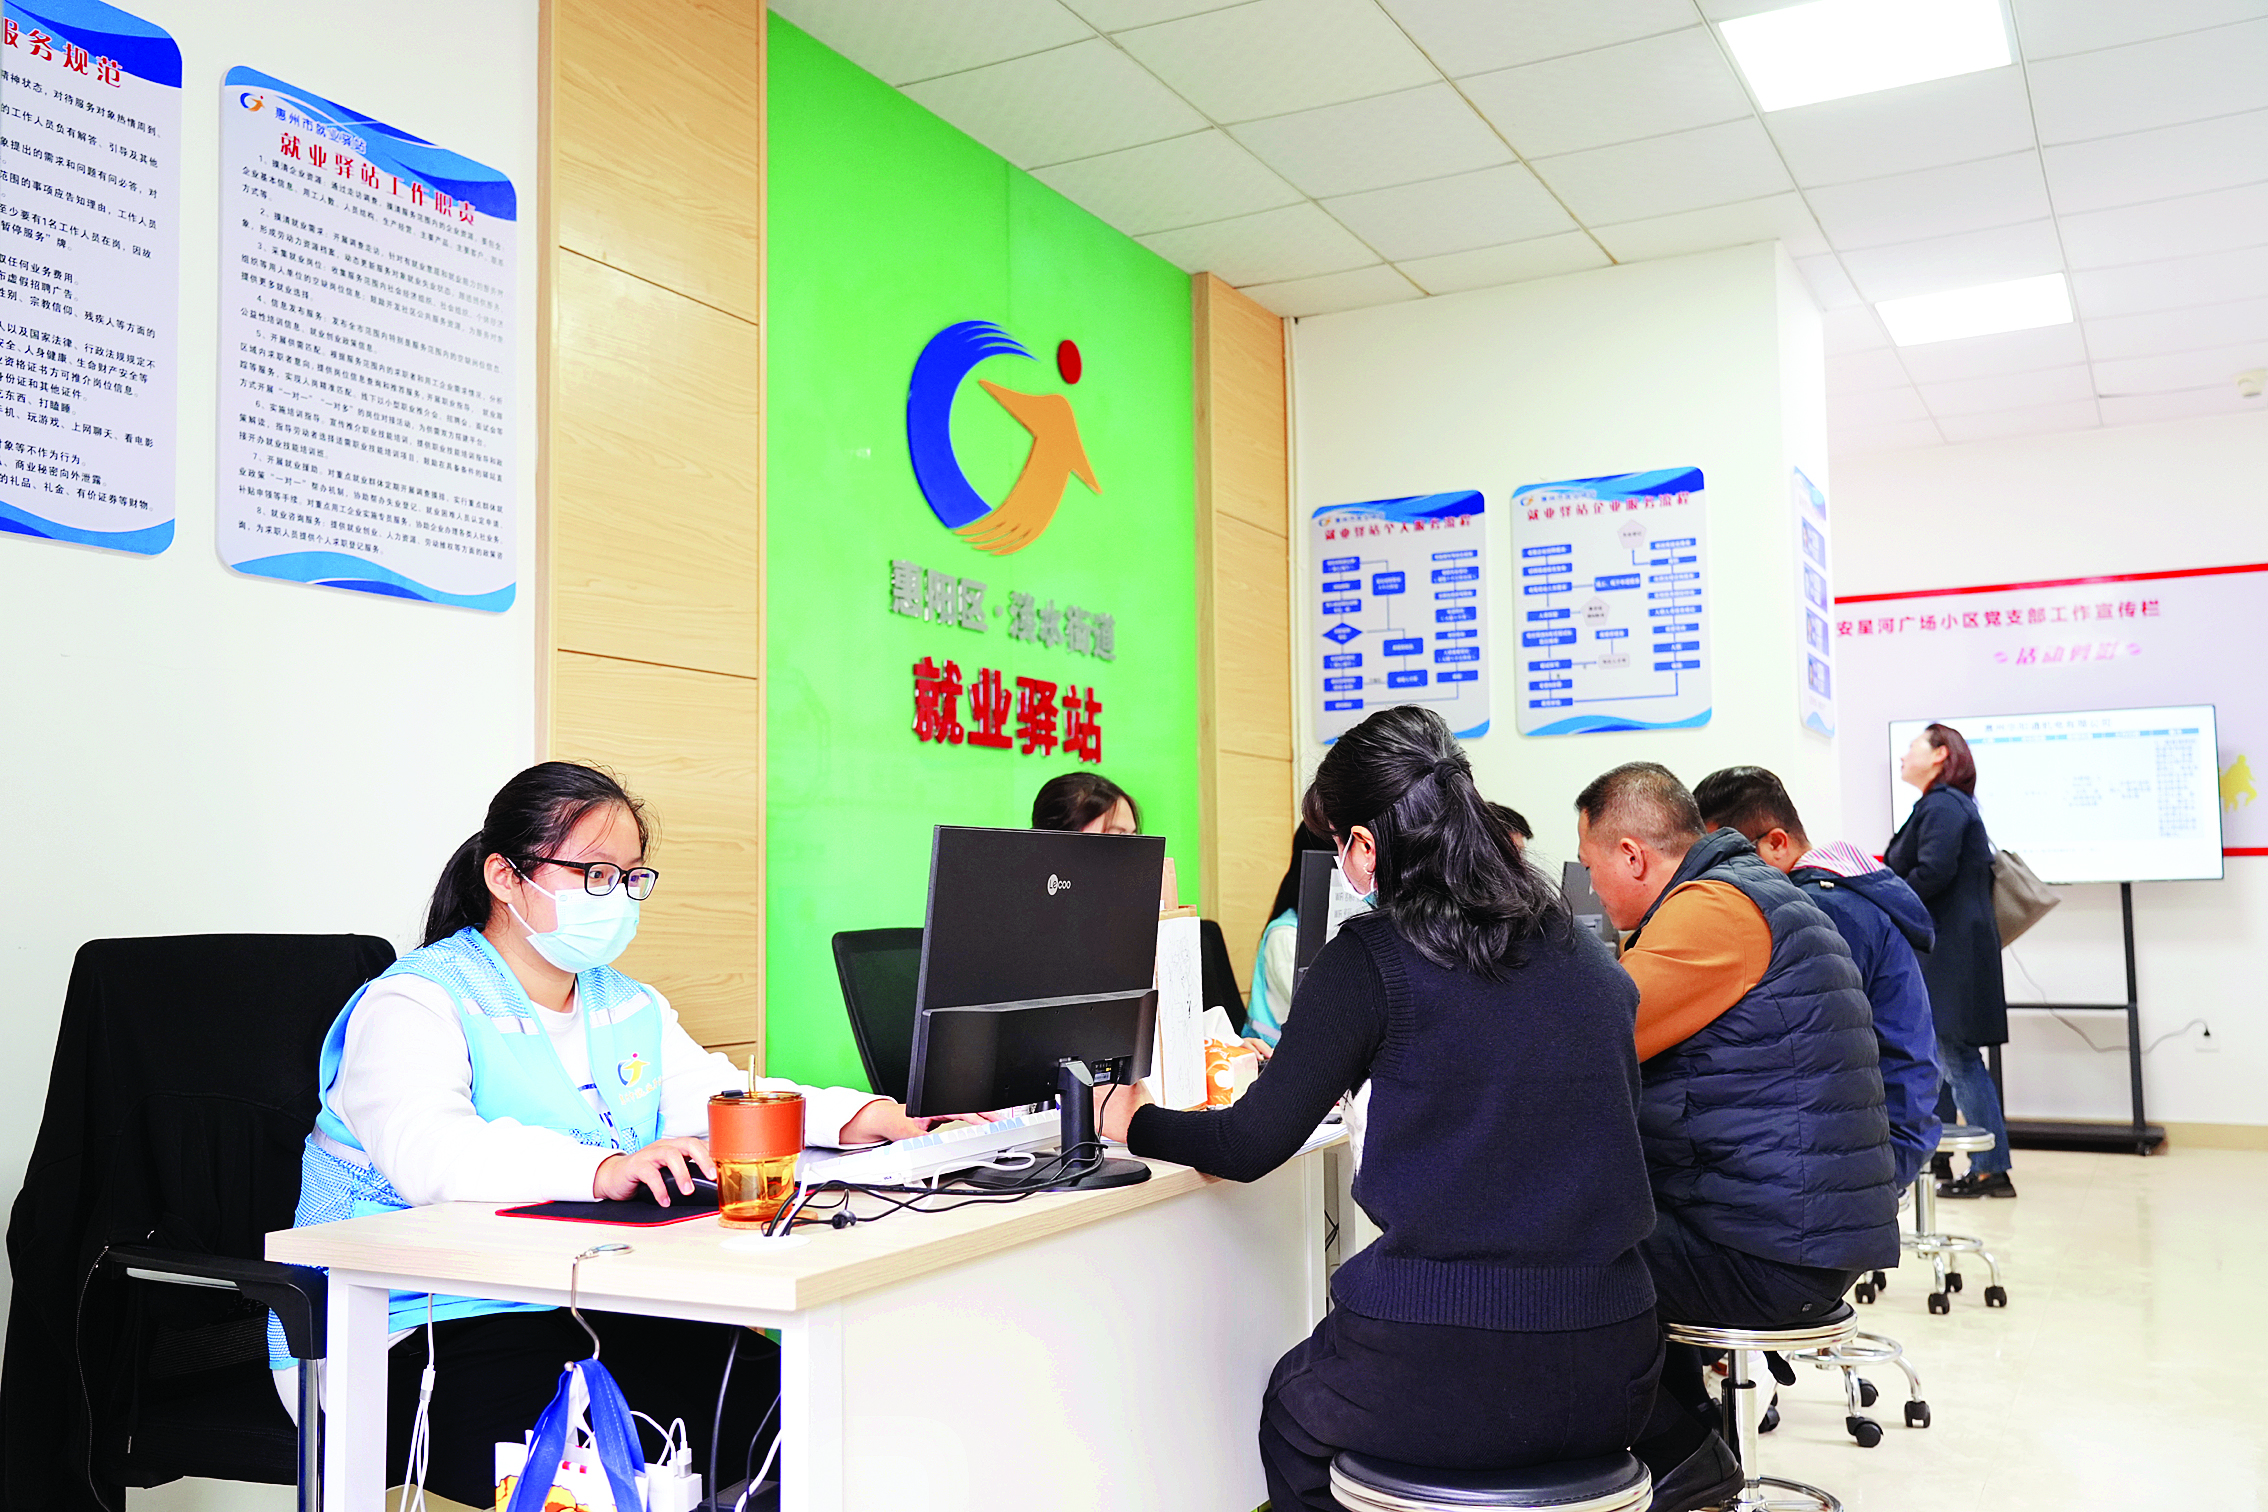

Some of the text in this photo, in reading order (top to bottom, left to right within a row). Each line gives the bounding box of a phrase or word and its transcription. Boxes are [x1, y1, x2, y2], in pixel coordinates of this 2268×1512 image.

[274, 106, 367, 154] 惠州市就业驿站
[280, 132, 477, 226] 就业驿站工作职责
[0, 401, 153, 451] 机、玩游戏、上网聊天、看电影
[0, 437, 85, 467] 象等不作为行为。
[0, 453, 106, 488] 、商业秘密向外泄露。
[1837, 600, 2160, 637] 安星河广场小区党支部工作宣传栏
[912, 656, 1103, 764] 就业驿站
